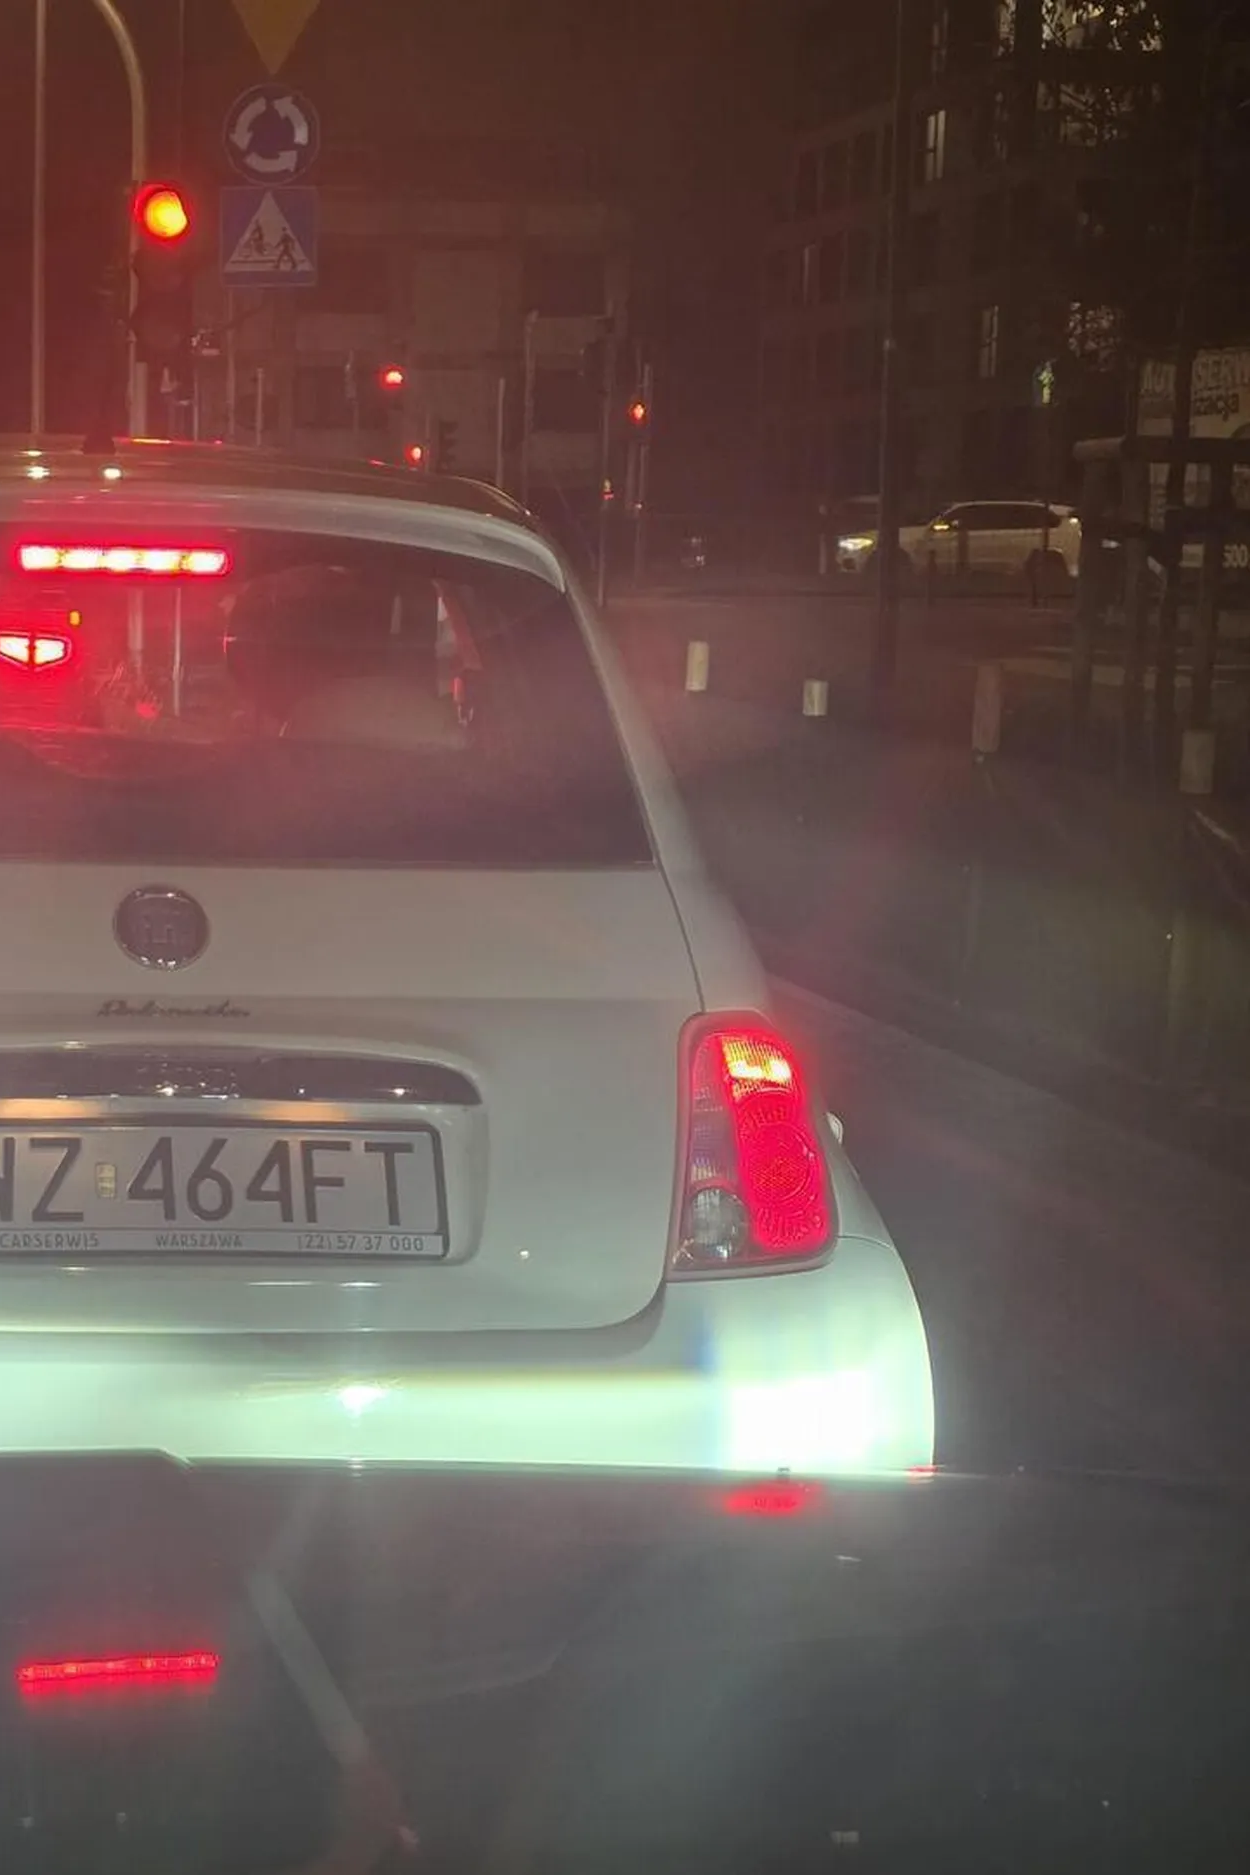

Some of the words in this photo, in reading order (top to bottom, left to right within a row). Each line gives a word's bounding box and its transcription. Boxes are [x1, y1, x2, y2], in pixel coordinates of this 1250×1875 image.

[127, 1138, 414, 1226] 464FT
[0, 1232, 100, 1249] CARSERWIS
[155, 1233, 244, 1248] WARSZAWA
[390, 1235, 424, 1252] 000
